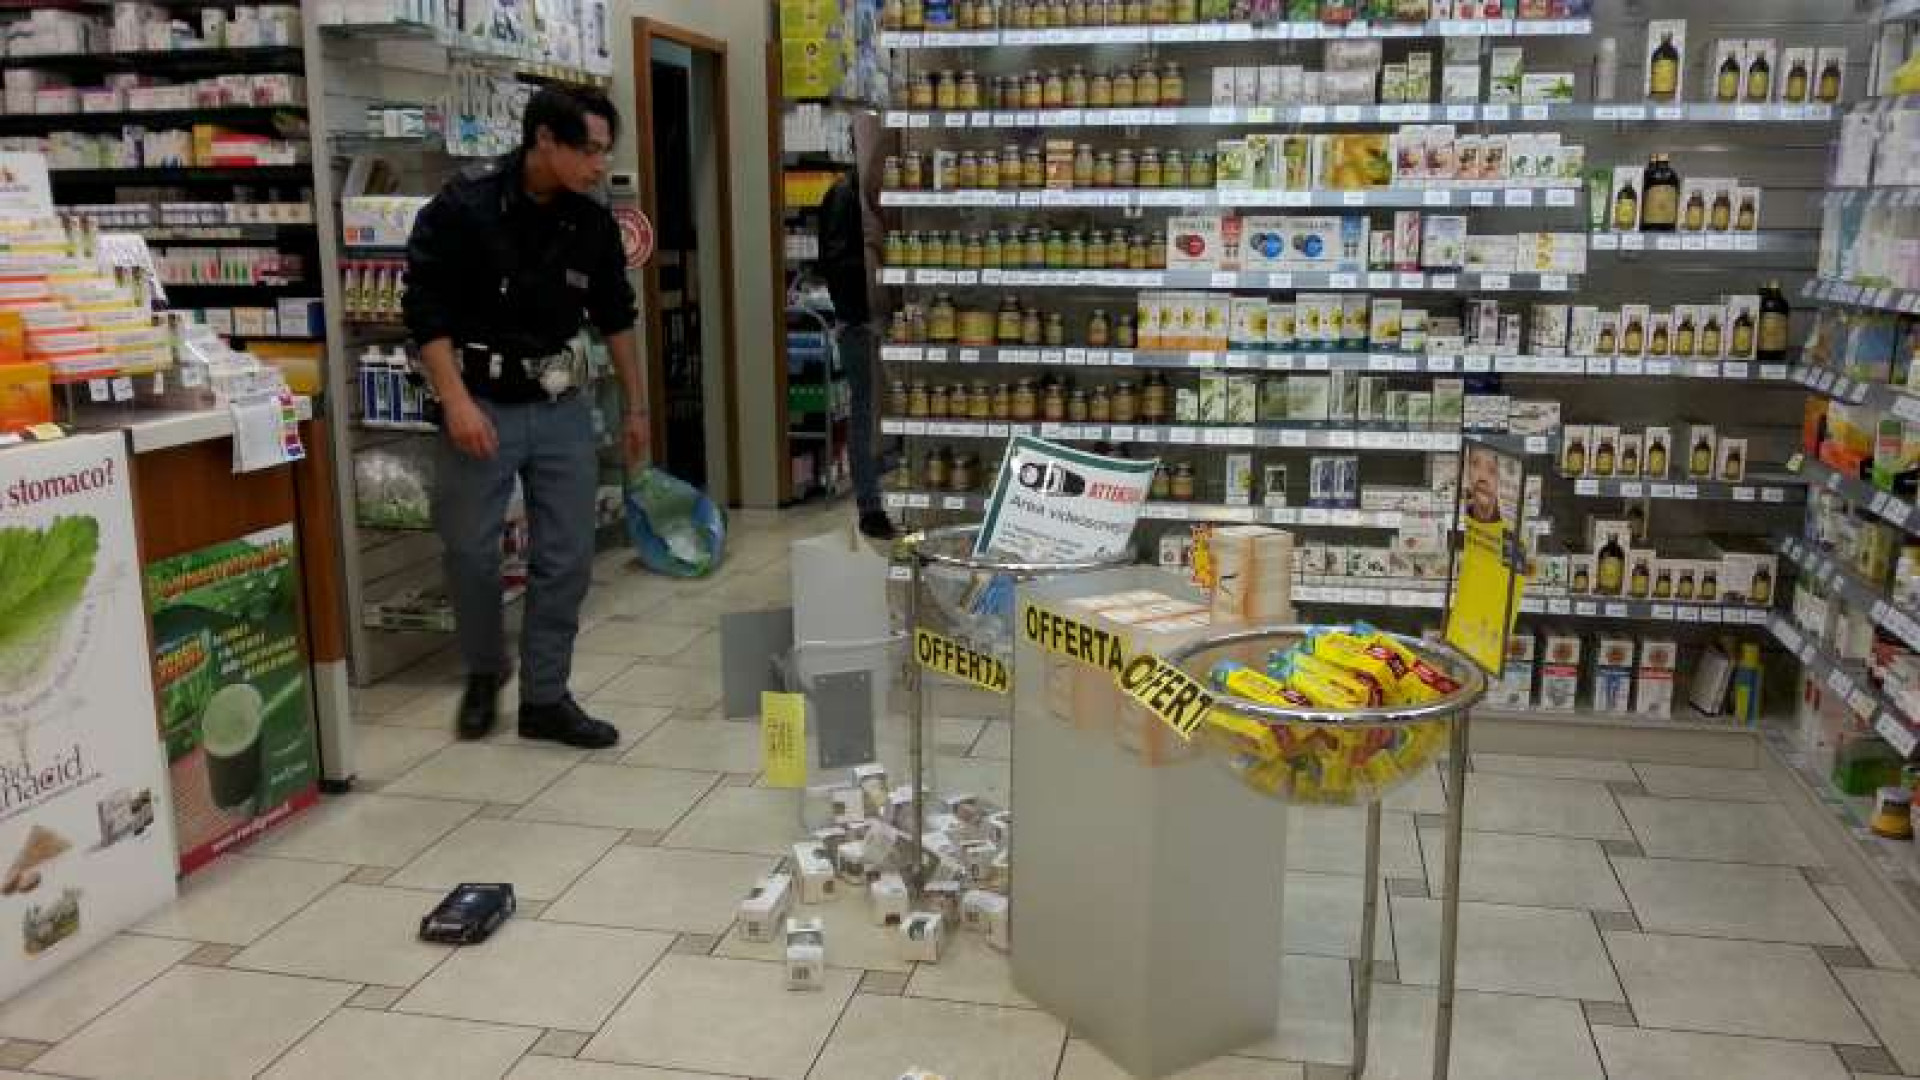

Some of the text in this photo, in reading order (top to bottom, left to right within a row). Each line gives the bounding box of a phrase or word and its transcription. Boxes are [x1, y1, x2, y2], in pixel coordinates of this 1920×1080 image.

[8, 457, 115, 505] stomaco?
[1010, 496, 1045, 518] Area
[917, 632, 1007, 691] OFFERTA
[1026, 604, 1124, 673] OFFERTA
[1121, 654, 1215, 735] OFFERT
